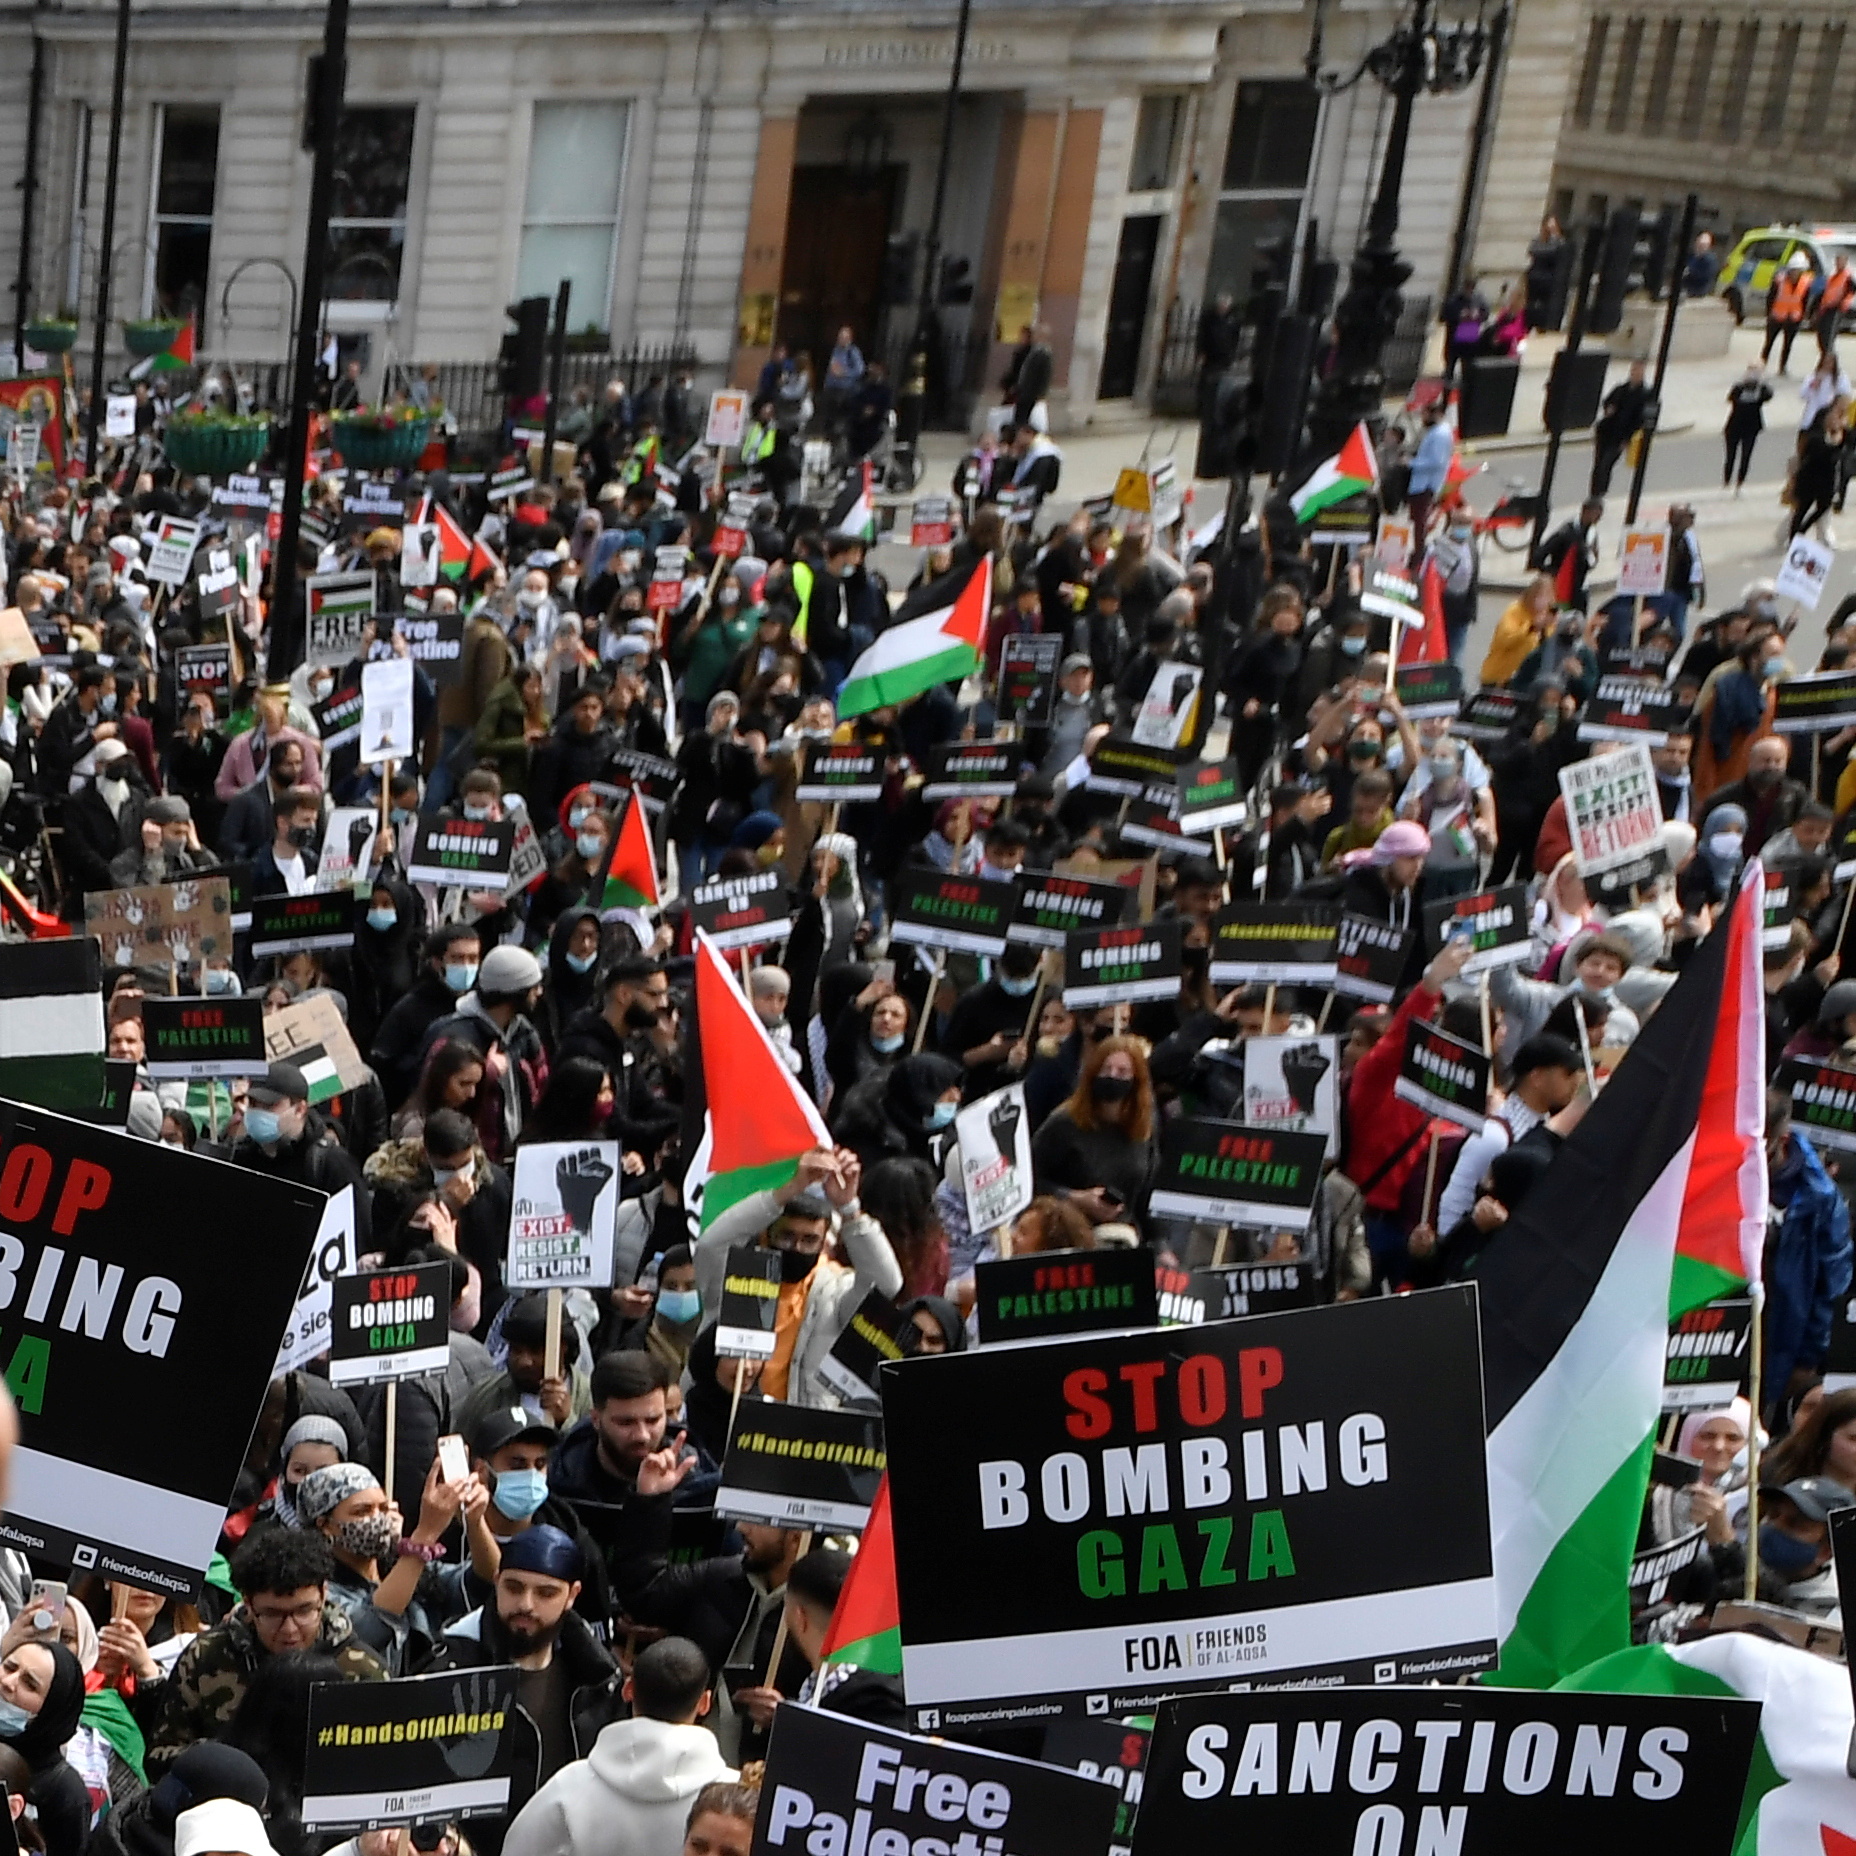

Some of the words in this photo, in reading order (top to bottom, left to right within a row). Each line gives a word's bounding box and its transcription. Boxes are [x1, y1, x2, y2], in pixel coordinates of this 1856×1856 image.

[1217, 1136, 1273, 1161] FREE
[1178, 1153, 1301, 1190] PALESTINE
[516, 1216, 572, 1236] EXIST.
[369, 1274, 419, 1300] STOP
[349, 1295, 435, 1329] BOMBING
[368, 1322, 417, 1350] GAZA
[1063, 1346, 1284, 1441] STOP
[978, 1412, 1391, 1530] BOMBING
[1076, 1510, 1296, 1601] GAZA
[101, 1554, 190, 1594] friendsofalaqsa
[1125, 1632, 1181, 1673] FOA
[1195, 1623, 1267, 1649] FRIENDS
[1198, 1650, 1212, 1665] OF
[1216, 1644, 1268, 1663] AL-AQSA
[1400, 1650, 1489, 1678] friendsofalaqsa
[317, 1709, 505, 1749] #HandsOffAlAqsa
[944, 1702, 1063, 1724] foapeaceinpalestine
[1182, 1718, 1690, 1802] SANCTIONS
[854, 1741, 1011, 1831] Free
